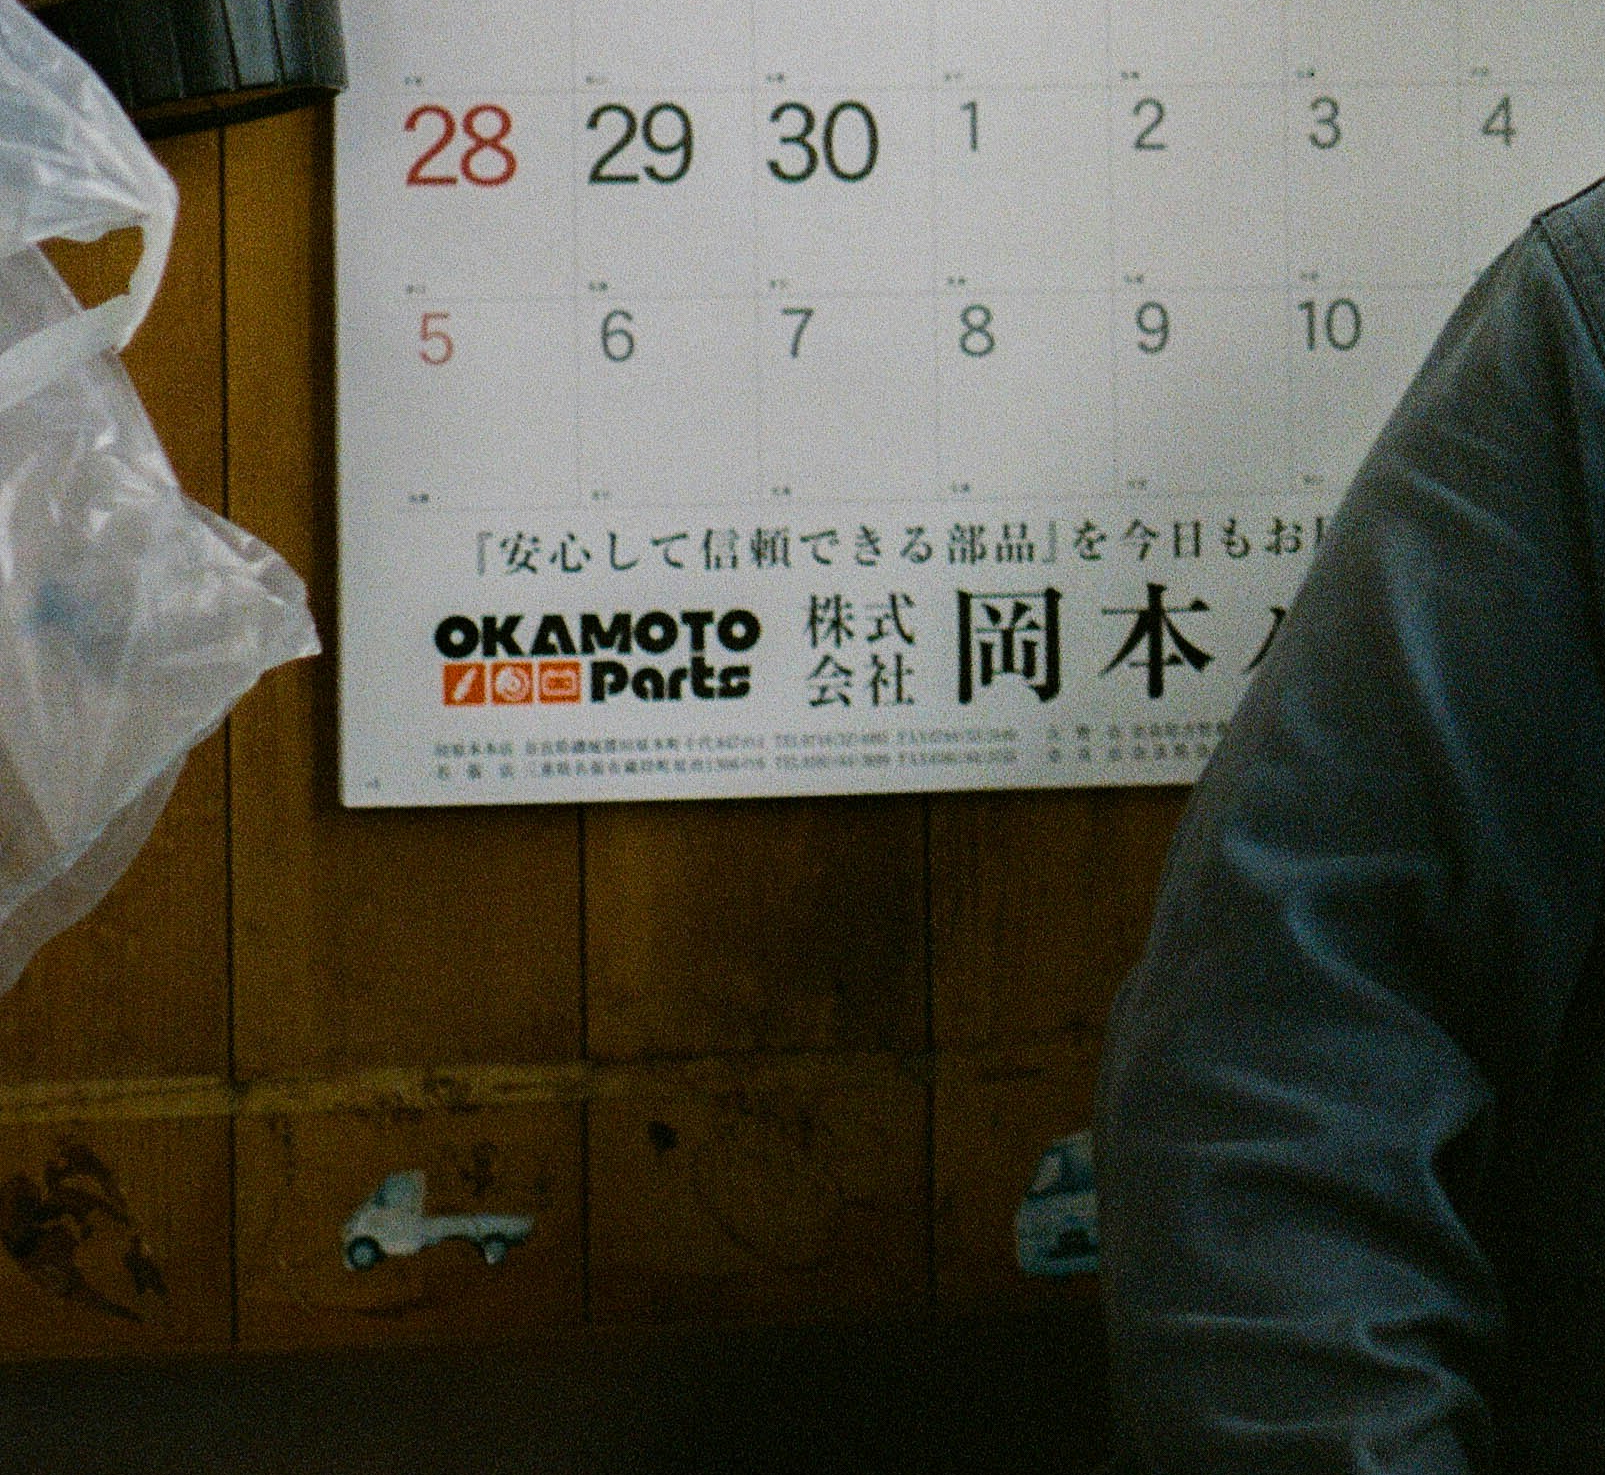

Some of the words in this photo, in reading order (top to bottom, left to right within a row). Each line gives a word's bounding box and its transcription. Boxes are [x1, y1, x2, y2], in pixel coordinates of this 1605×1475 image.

[405, 104, 517, 186] 28
[587, 103, 693, 184] 29
[768, 100, 879, 184] 30
[961, 101, 978, 152] 1
[1133, 98, 1166, 151] 2
[1309, 96, 1342, 150] 3
[1481, 95, 1516, 146] 4
[419, 312, 454, 366] 5
[601, 309, 635, 362] 6
[782, 308, 814, 358] 7
[959, 304, 995, 358] 8
[1136, 302, 1170, 354] 9
[1298, 298, 1362, 351] 10
[433, 609, 762, 659] OKAMOTO
[808, 592, 917, 649] 株式
[590, 658, 751, 704] Parts
[807, 652, 916, 709] 会社
